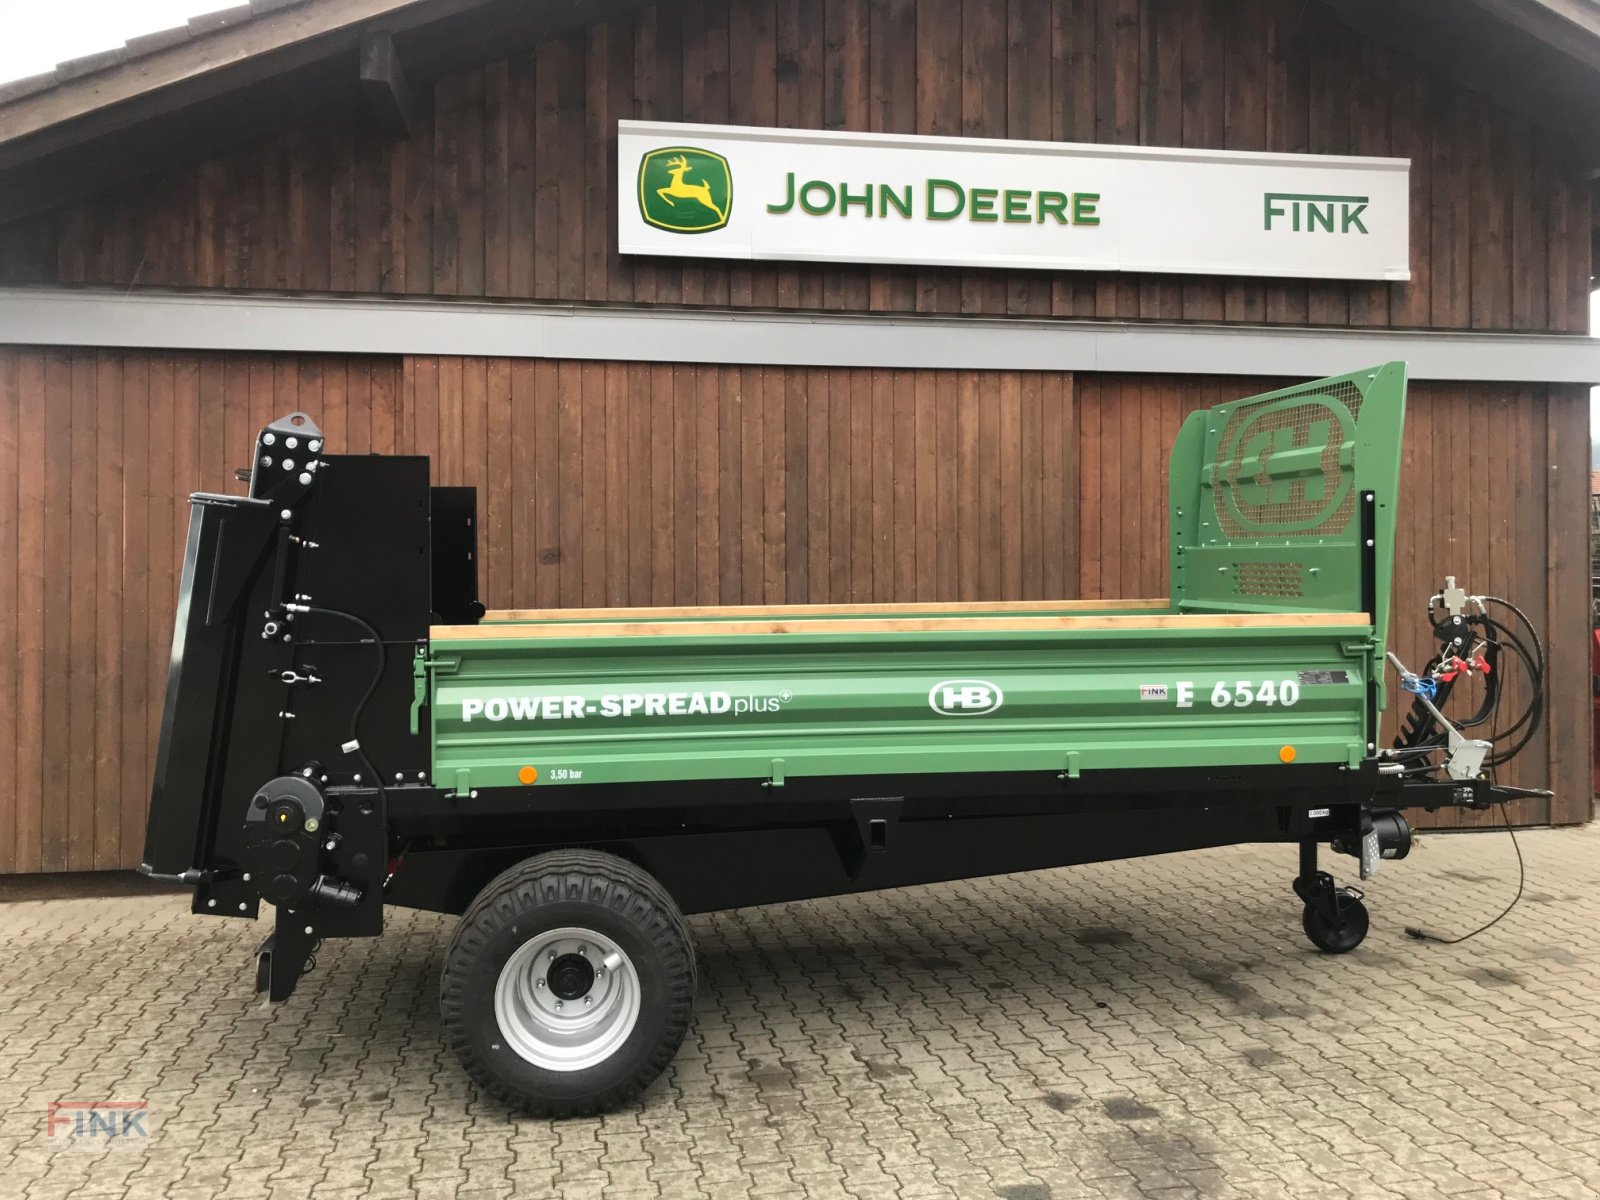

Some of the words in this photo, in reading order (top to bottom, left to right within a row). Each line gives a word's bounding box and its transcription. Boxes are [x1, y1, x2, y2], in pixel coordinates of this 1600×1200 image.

[1264, 192, 1369, 234] FINK
[942, 686, 993, 709] HB
[1141, 686, 1166, 695] FINK
[1175, 681, 1194, 708] E
[1210, 679, 1299, 707] 6540
[550, 769, 568, 780] 3,50
[569, 769, 583, 779] bar
